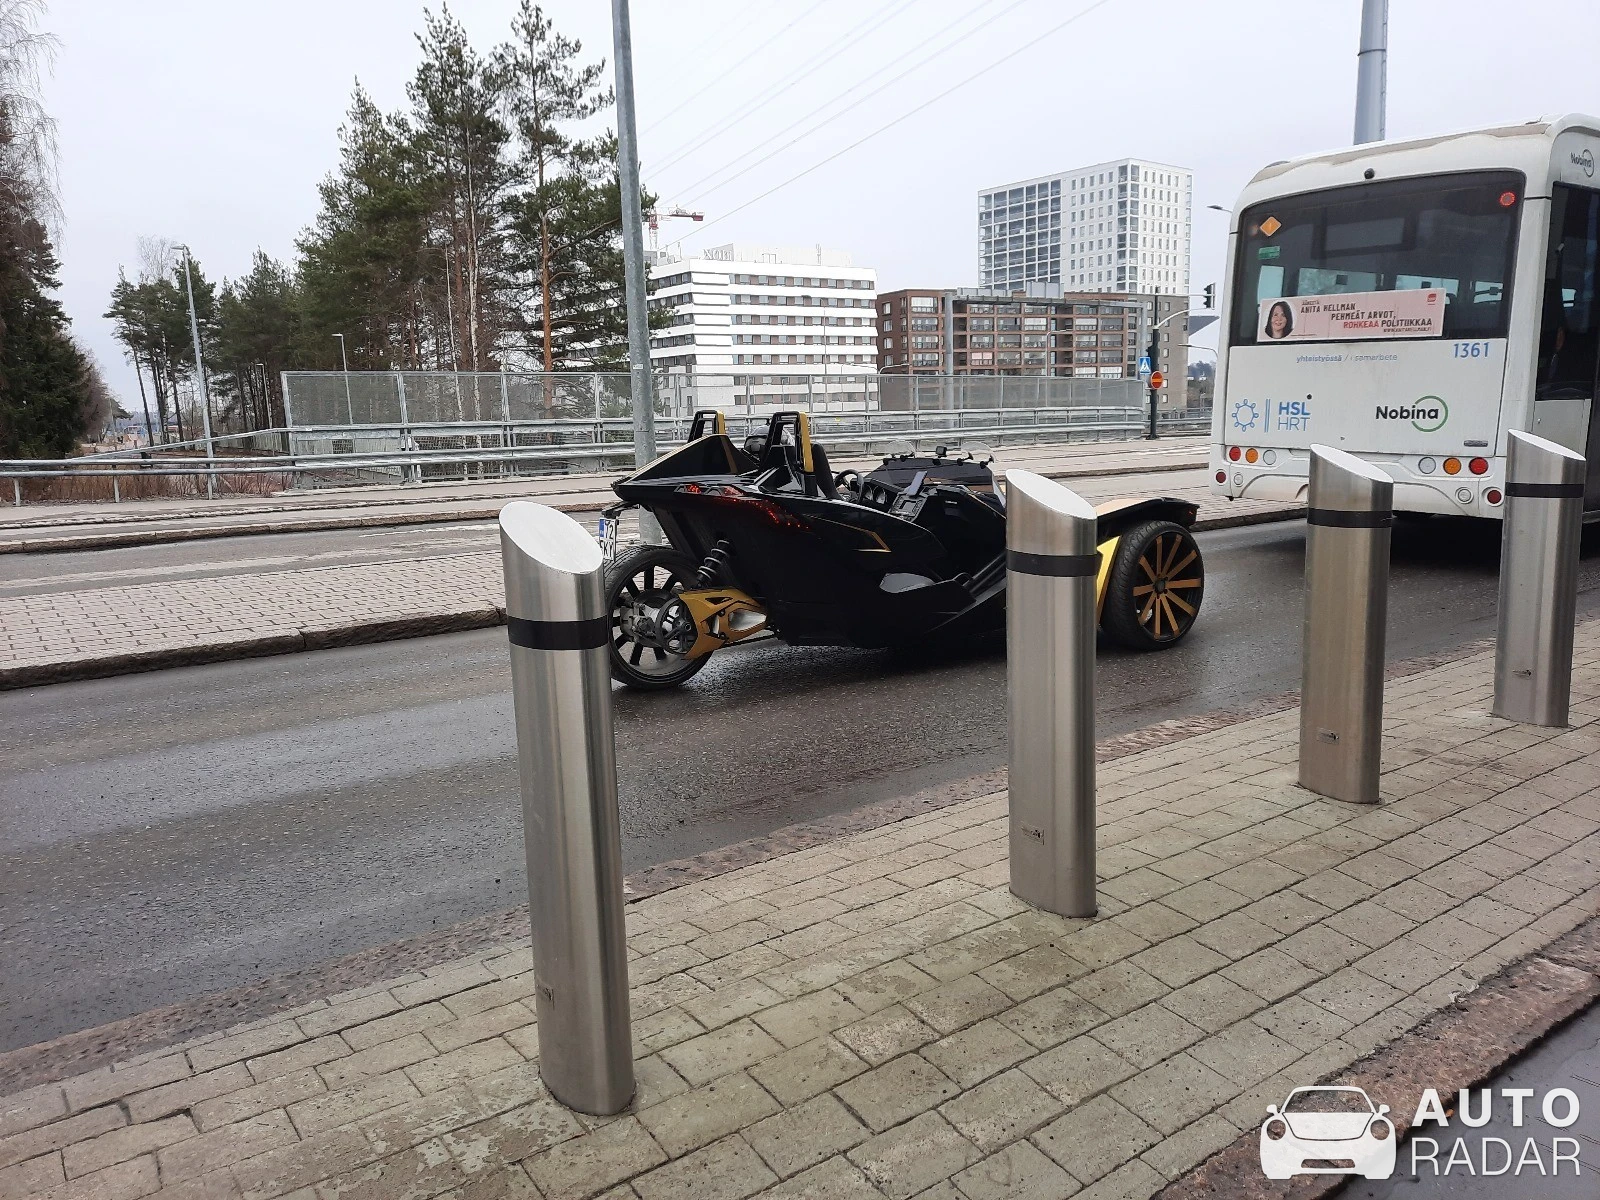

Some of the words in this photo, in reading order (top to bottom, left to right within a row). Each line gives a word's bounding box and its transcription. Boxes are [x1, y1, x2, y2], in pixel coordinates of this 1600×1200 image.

[1301, 305, 1320, 313] ANITA
[1323, 303, 1356, 312] HELLMAN
[1331, 309, 1364, 320] PEHMEÄT
[1367, 310, 1396, 320] ARVOT,
[1343, 320, 1379, 329] ROHKEAA
[1381, 318, 1432, 328] POLITIIKKAA
[1453, 342, 1490, 358] 1361
[1296, 354, 1342, 363] yhteistyössä
[1354, 353, 1398, 361] samarbete
[1278, 401, 1311, 415] HSL
[1375, 405, 1439, 420] Nobina
[1277, 416, 1311, 432] HRT
